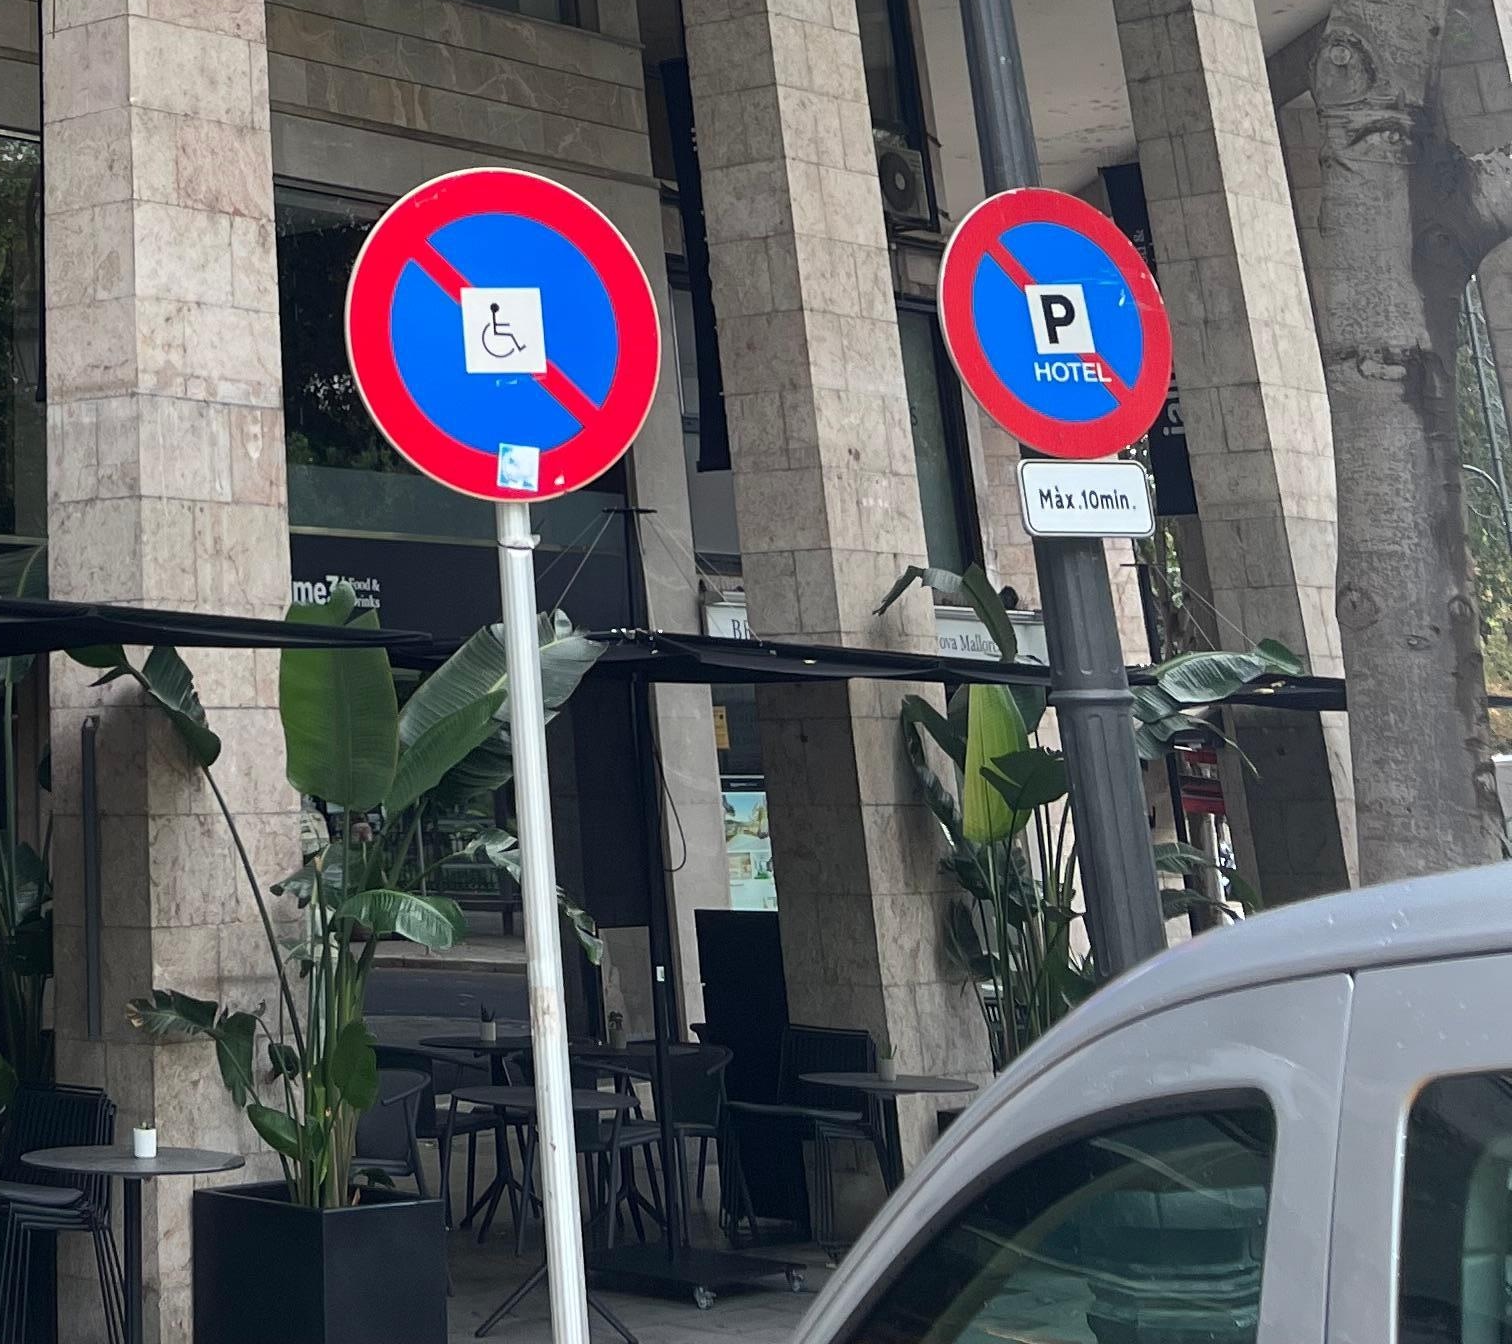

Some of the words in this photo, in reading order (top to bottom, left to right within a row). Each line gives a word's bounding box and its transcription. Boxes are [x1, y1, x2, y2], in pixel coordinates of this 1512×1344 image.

[1039, 294, 1076, 345] P
[1033, 362, 1112, 383] HOTEL
[354, 594, 381, 608] rinks
[939, 635, 958, 650] ova
